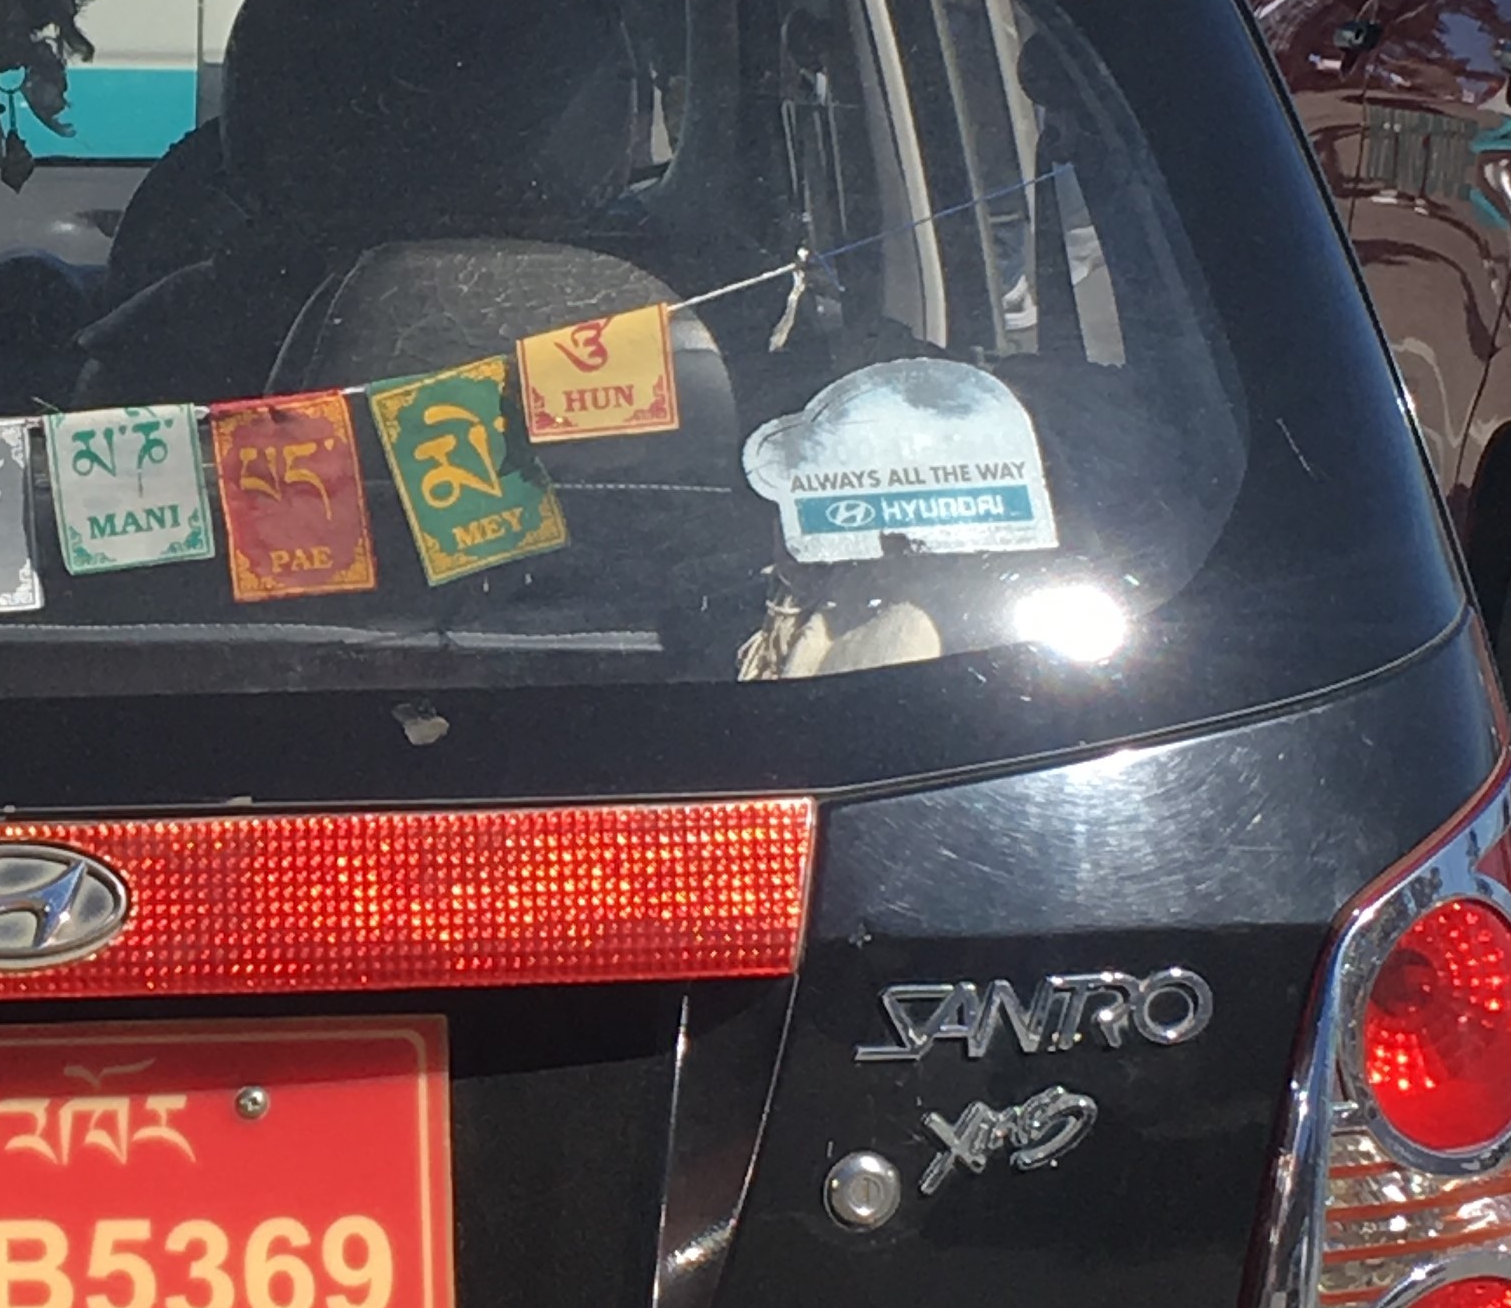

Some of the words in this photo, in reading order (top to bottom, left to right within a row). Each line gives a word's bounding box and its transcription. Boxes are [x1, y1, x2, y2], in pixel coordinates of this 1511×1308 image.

[562, 384, 636, 413] HUN
[790, 469, 882, 493] ALWAYS
[887, 466, 927, 487] ALL
[929, 463, 972, 484] THE
[974, 461, 1026, 482] WAY
[87, 504, 181, 540] MANI
[881, 494, 1004, 522] HYUNDAI
[451, 506, 525, 550] MEY
[269, 546, 333, 574] PAE
[853, 966, 1214, 1062] SANTRO
